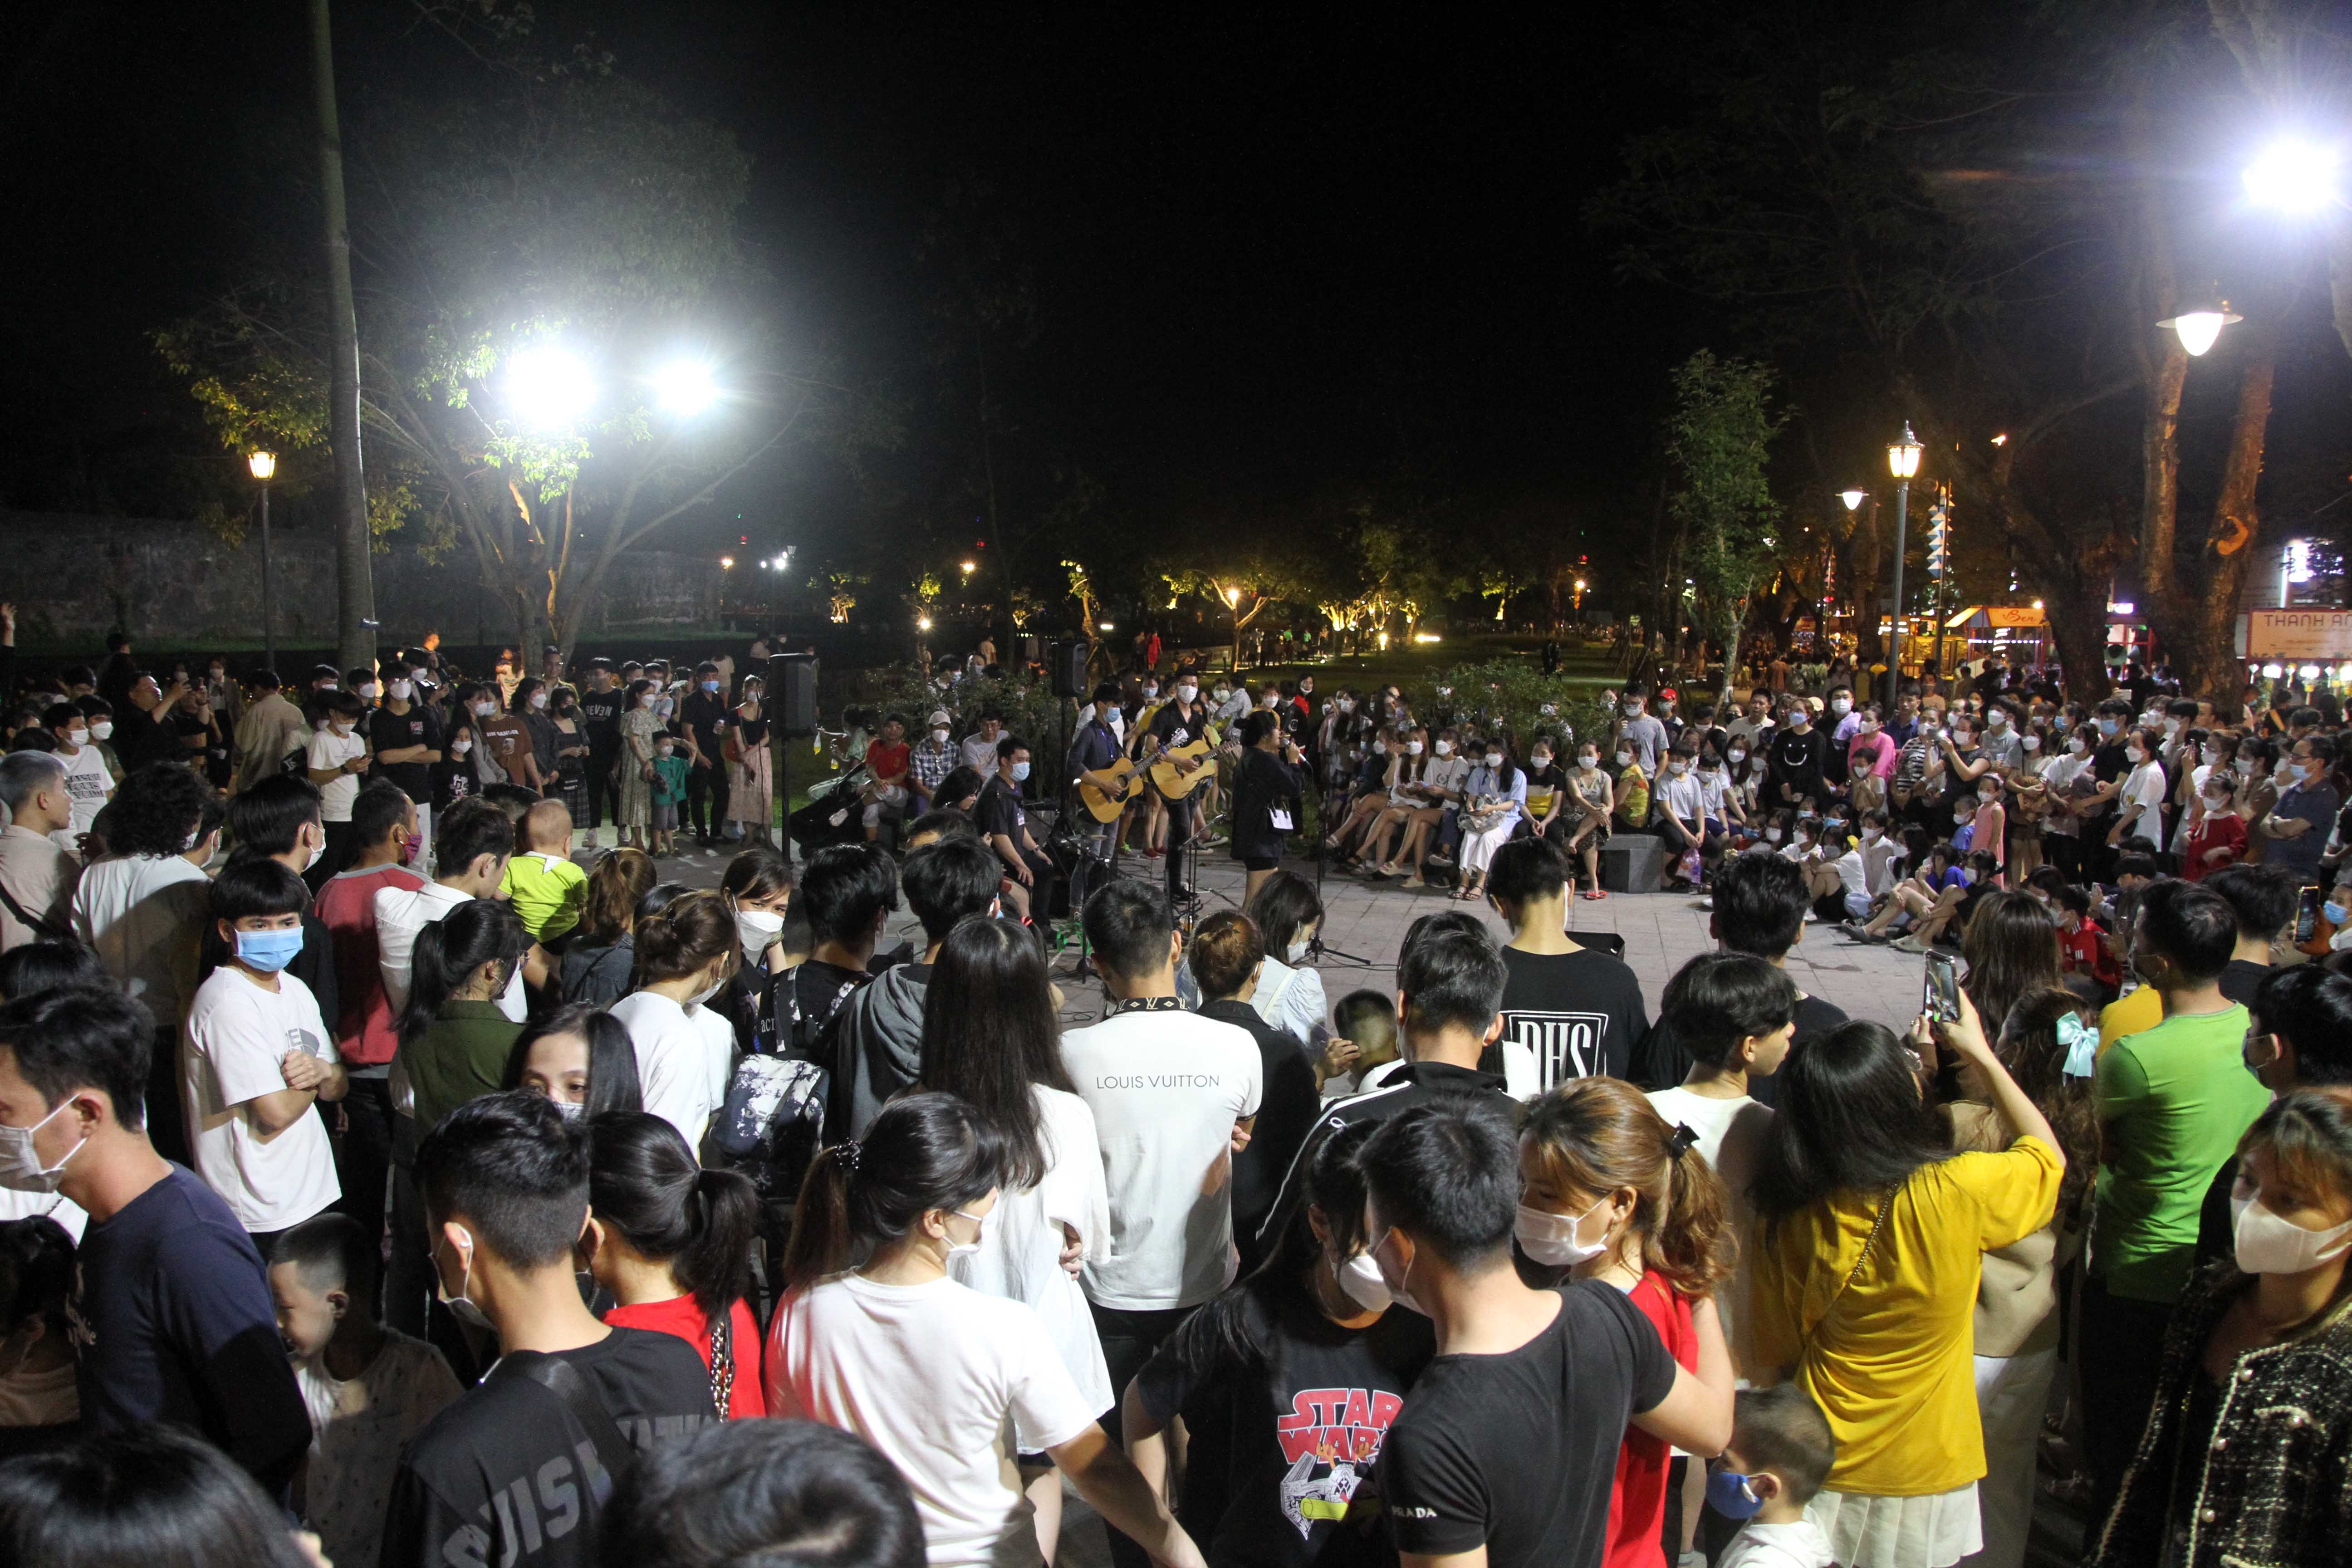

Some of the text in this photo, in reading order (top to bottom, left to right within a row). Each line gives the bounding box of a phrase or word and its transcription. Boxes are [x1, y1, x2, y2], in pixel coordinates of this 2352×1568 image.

[2264, 614, 2324, 627] THANH
[1096, 1075, 1219, 1089] LOUIS VUITTON
[1278, 1387, 1403, 1431] STAR
[1277, 1426, 1387, 1465] WAR
